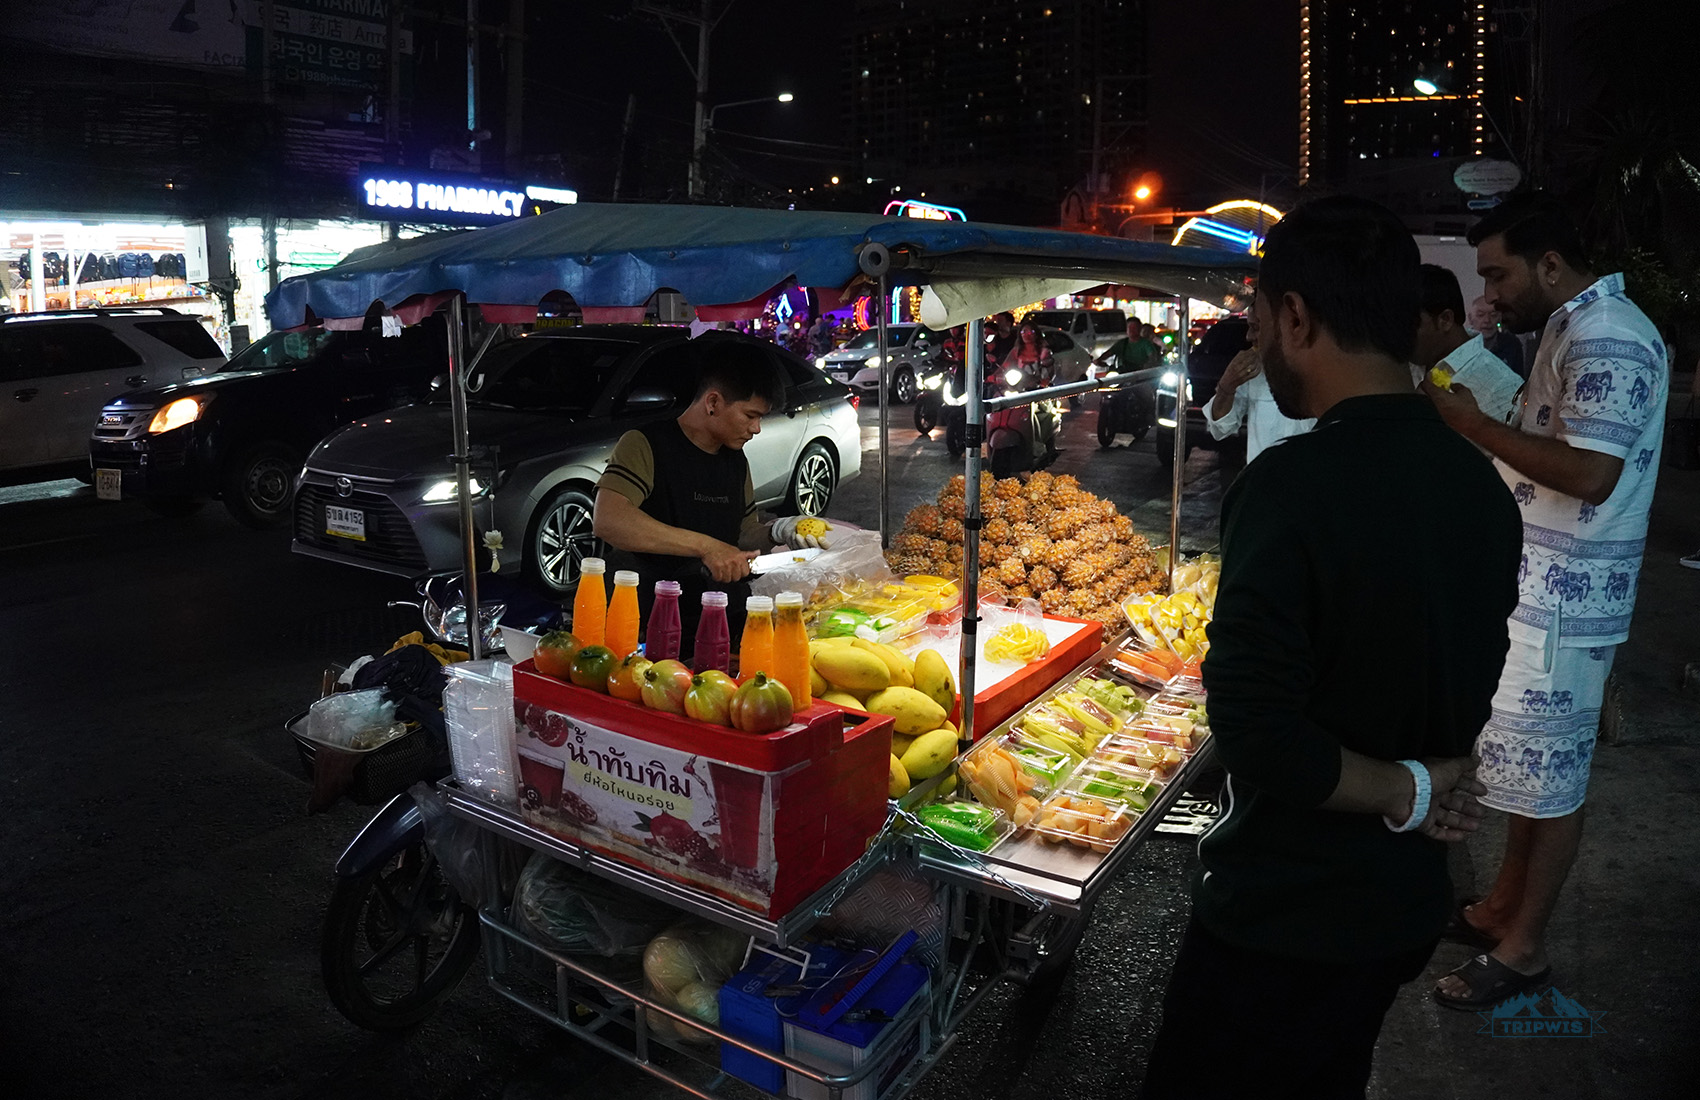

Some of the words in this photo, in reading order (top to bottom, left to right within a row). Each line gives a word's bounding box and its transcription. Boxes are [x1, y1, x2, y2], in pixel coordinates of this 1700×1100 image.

[309, 15, 342, 39] 药店
[328, 47, 360, 71] 운영
[416, 183, 525, 217] PHARMACY
[344, 510, 364, 525] 4152
[567, 726, 691, 798] น้ำทับทิม
